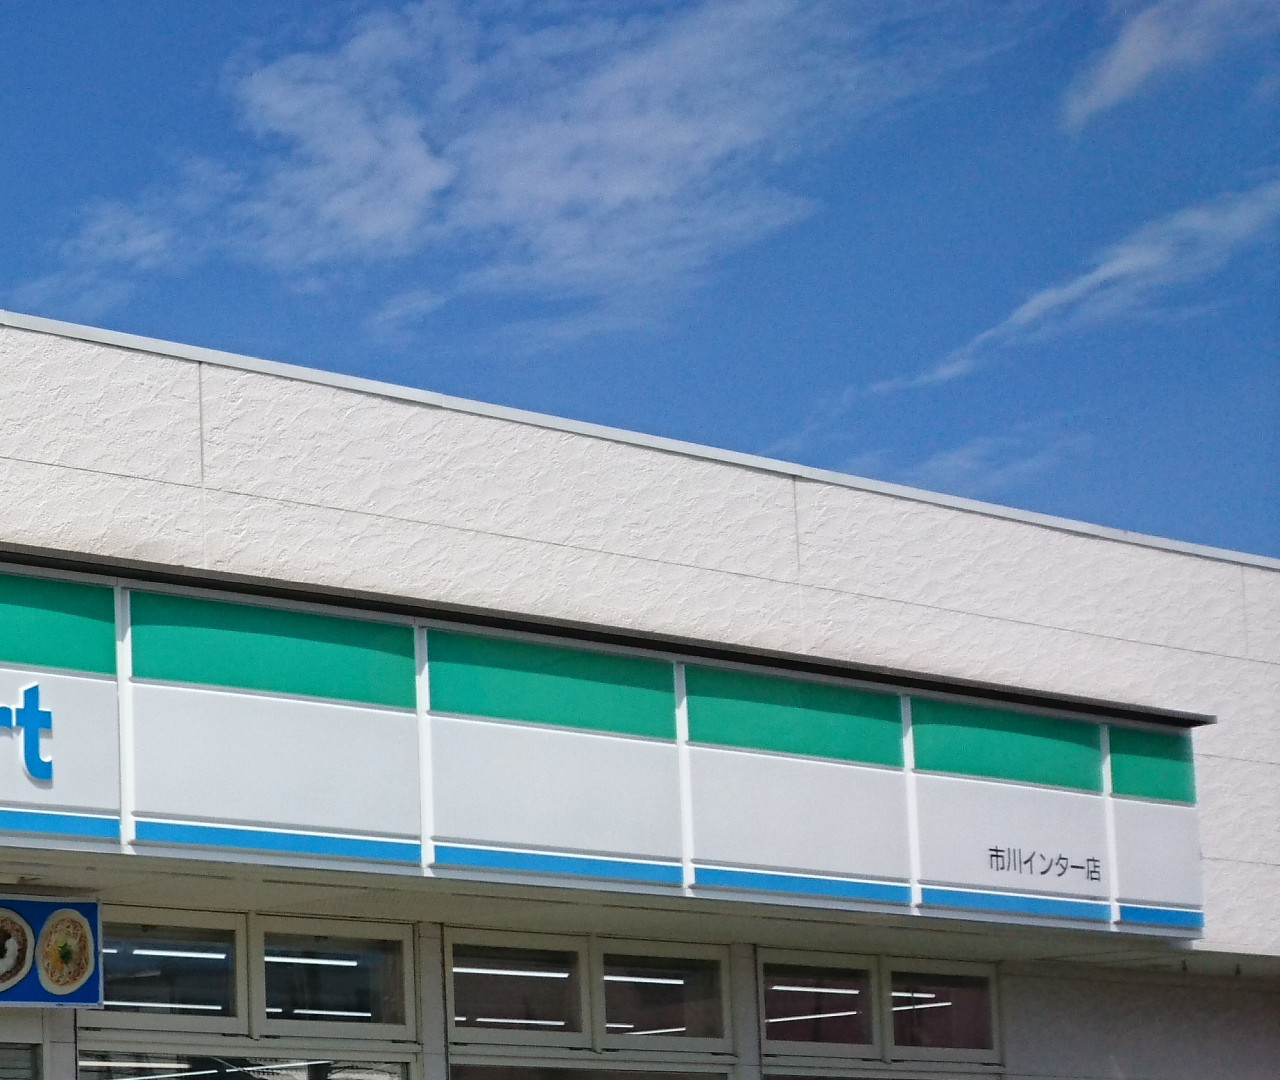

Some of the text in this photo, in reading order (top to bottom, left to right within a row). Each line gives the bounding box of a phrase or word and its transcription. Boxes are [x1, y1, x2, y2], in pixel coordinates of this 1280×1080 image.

[988, 845, 1101, 881] 市川インター店
